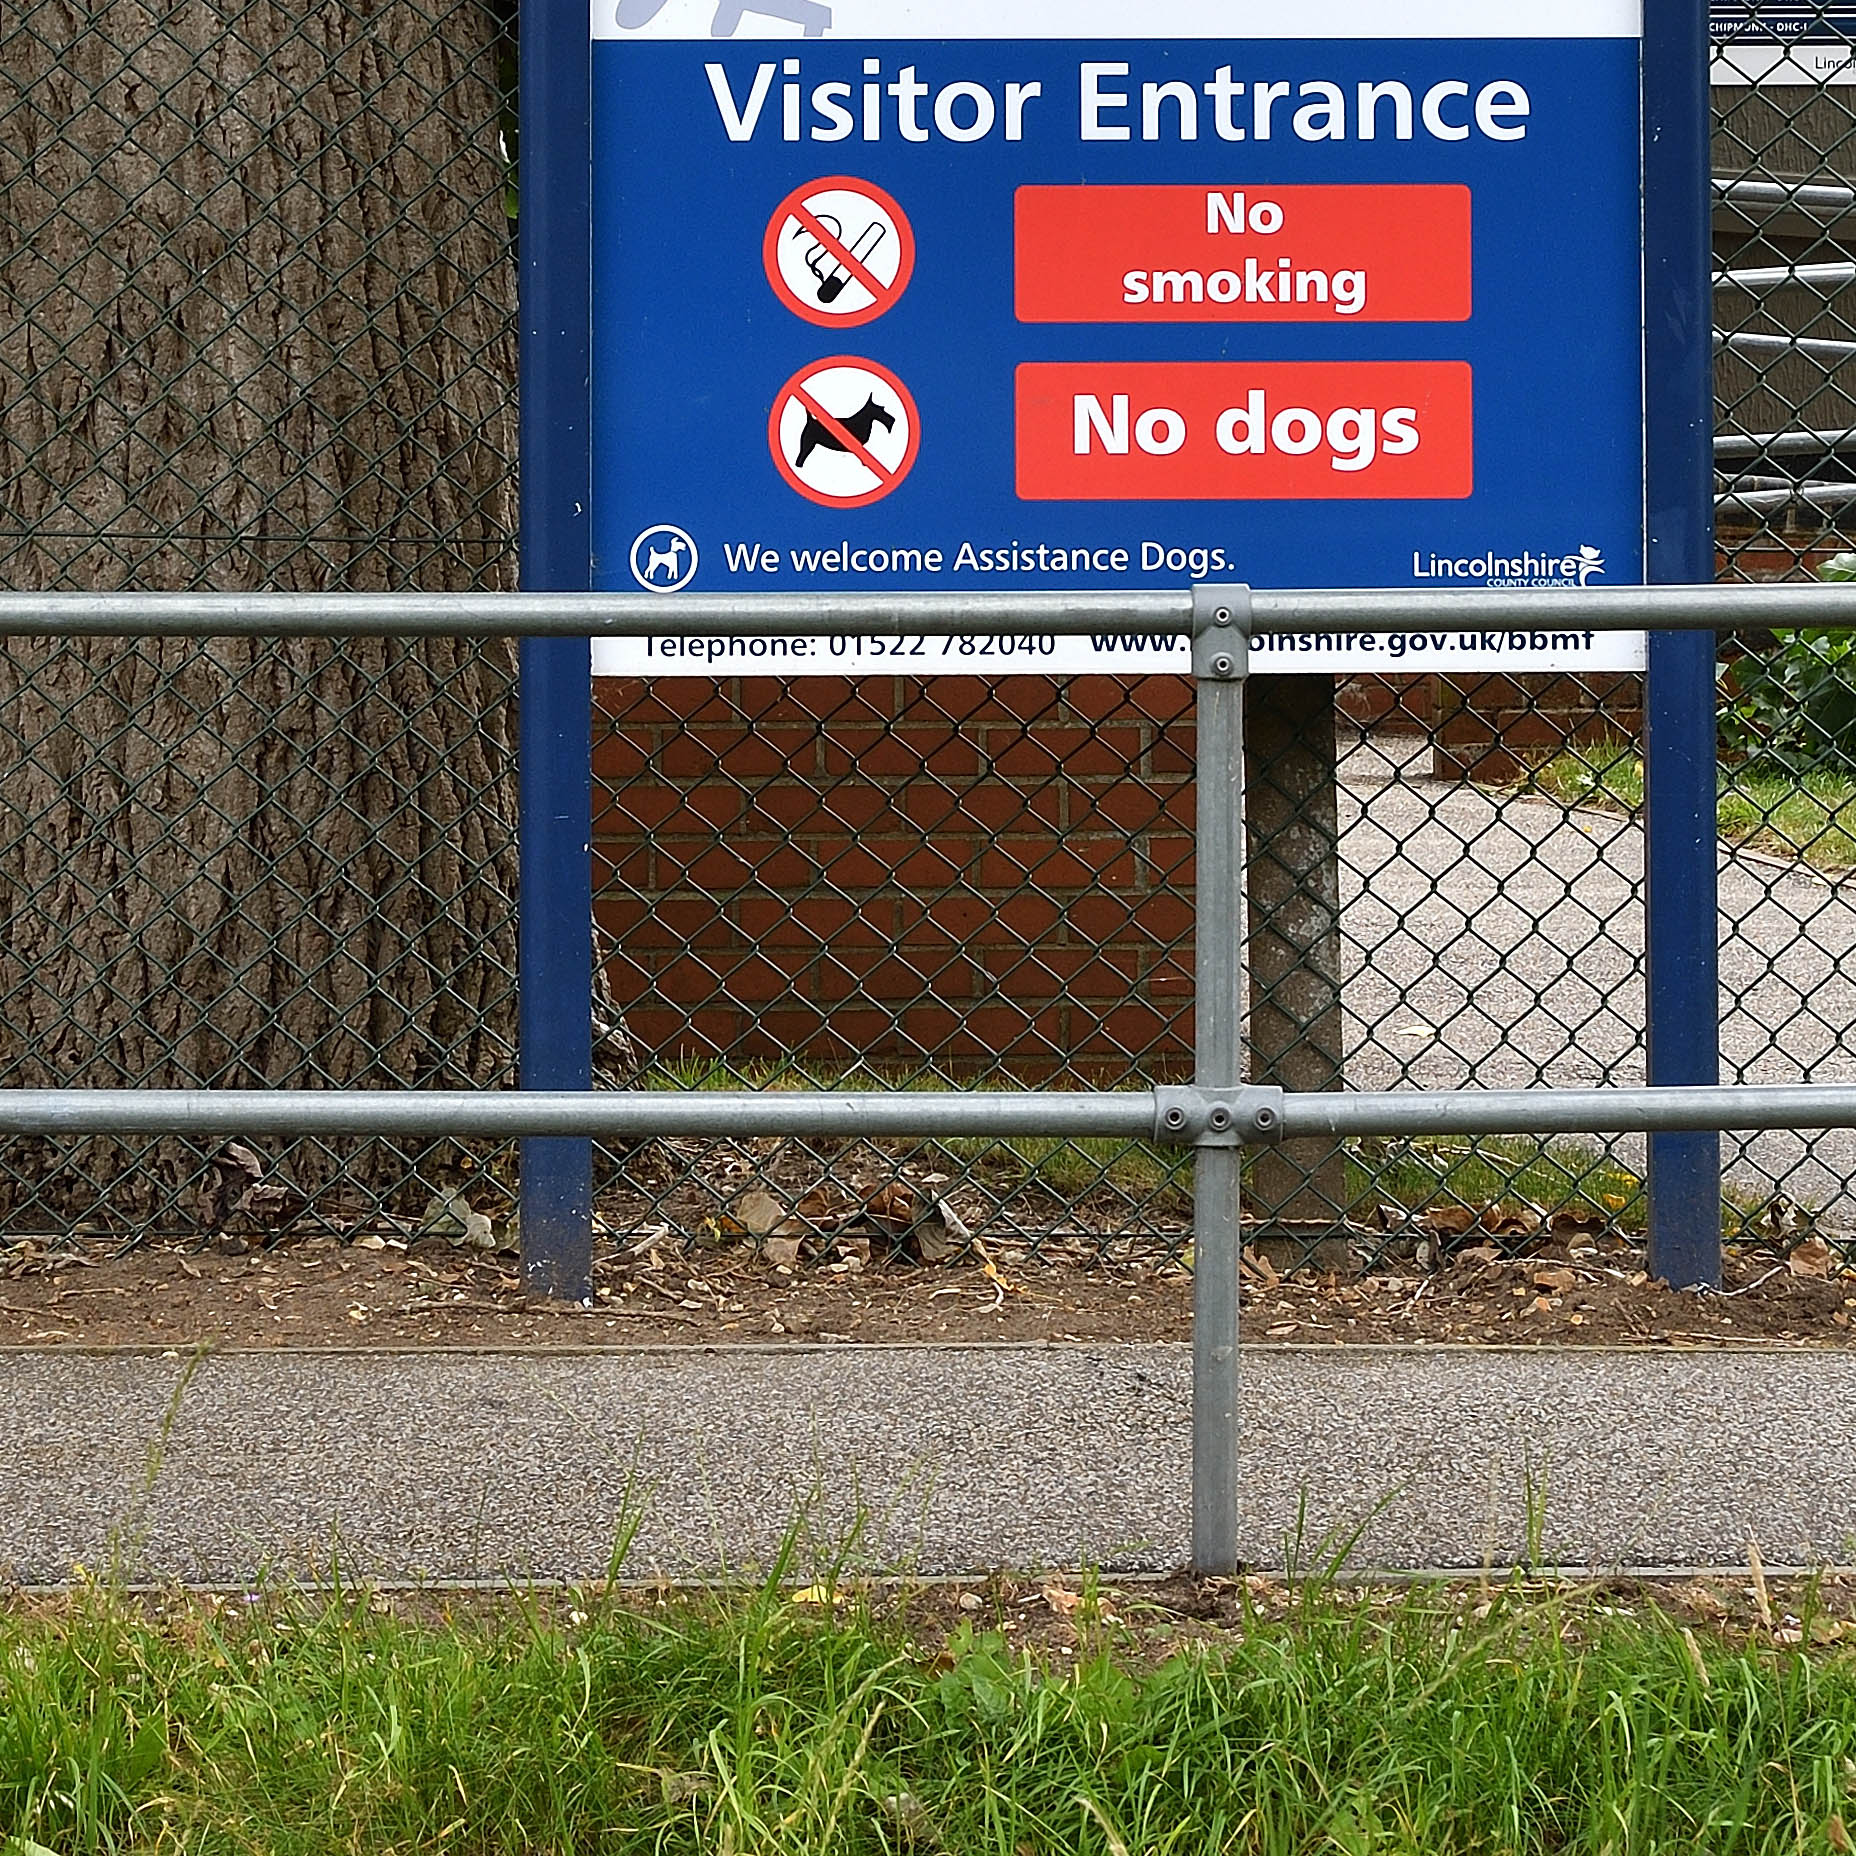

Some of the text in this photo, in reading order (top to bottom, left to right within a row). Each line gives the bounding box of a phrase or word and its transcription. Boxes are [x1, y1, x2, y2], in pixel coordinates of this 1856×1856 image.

[704, 58, 1530, 142] Visitor Entrance
[1207, 192, 1284, 234] No
[1123, 257, 1366, 314] smoking
[1074, 389, 1419, 471] No dogs
[723, 540, 1235, 579] We welcome Assistance Dogs.
[1413, 551, 1573, 577] Lincolnshire
[1486, 577, 1576, 588] COUNTY COUNCIL
[647, 636, 1056, 664] Telephone: 01522 782040
[1090, 635, 1595, 659] www.olnshire.gov.uk/bbmf
